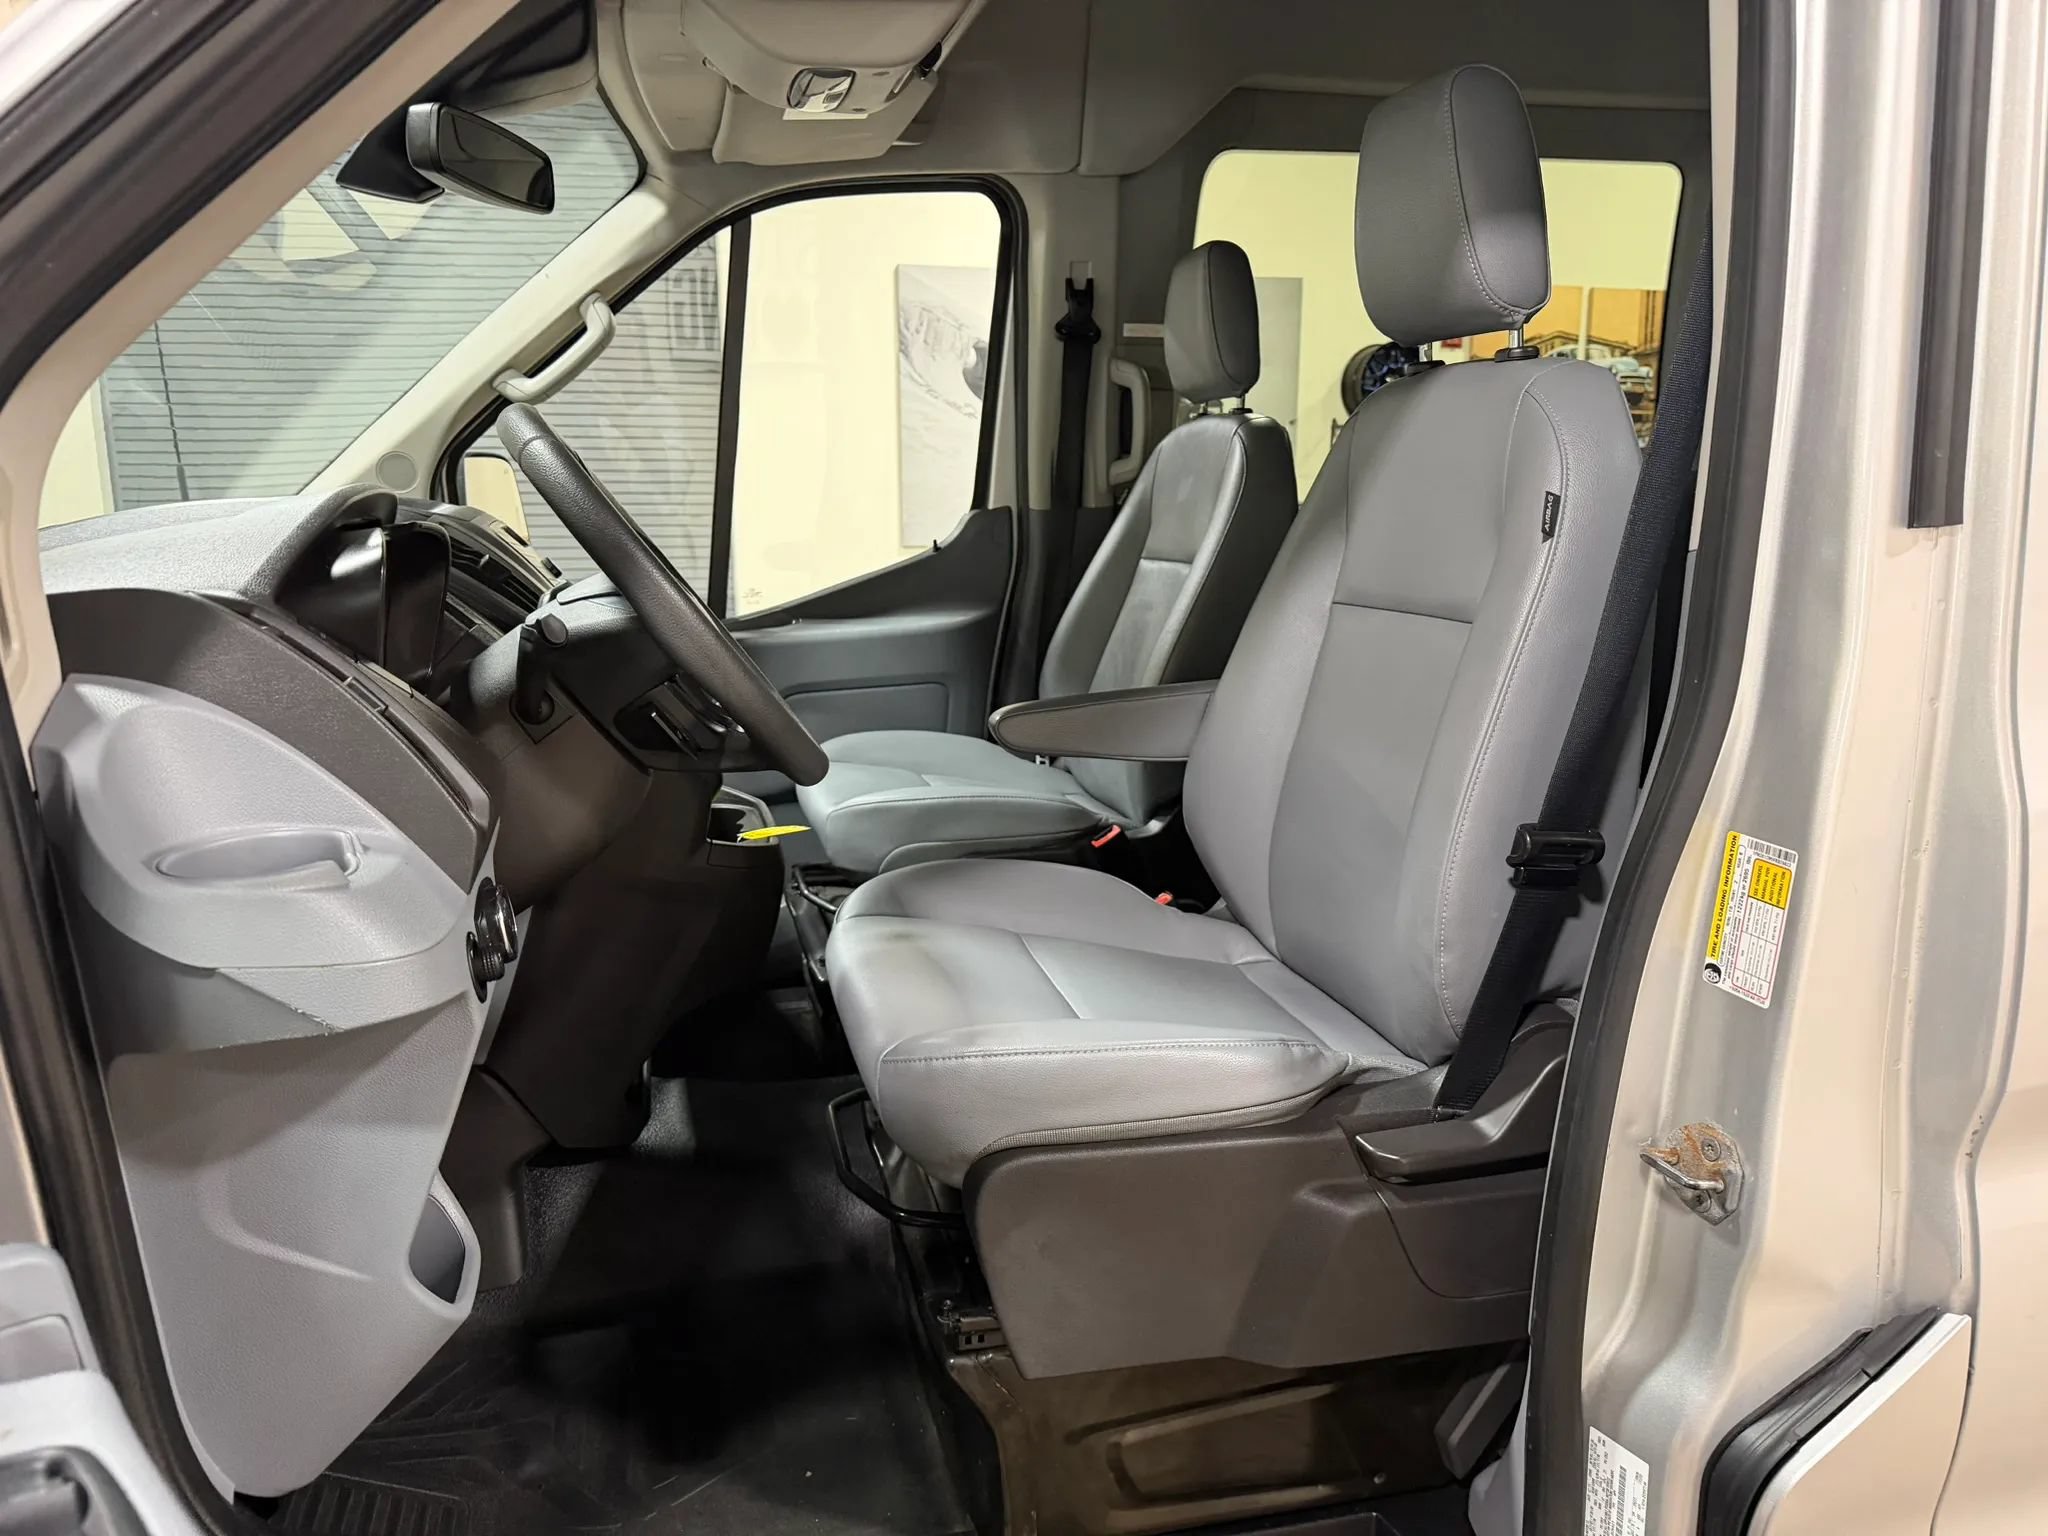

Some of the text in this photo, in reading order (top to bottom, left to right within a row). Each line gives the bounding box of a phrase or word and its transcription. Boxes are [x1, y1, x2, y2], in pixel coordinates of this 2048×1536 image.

[1544, 494, 1554, 532] AIRBAG
[1711, 939, 1719, 958] TIRE
[1718, 889, 1727, 922] LOADING
[1724, 835, 1737, 887] INFORMATION
[1769, 872, 1778, 902] ADDITIONAL
